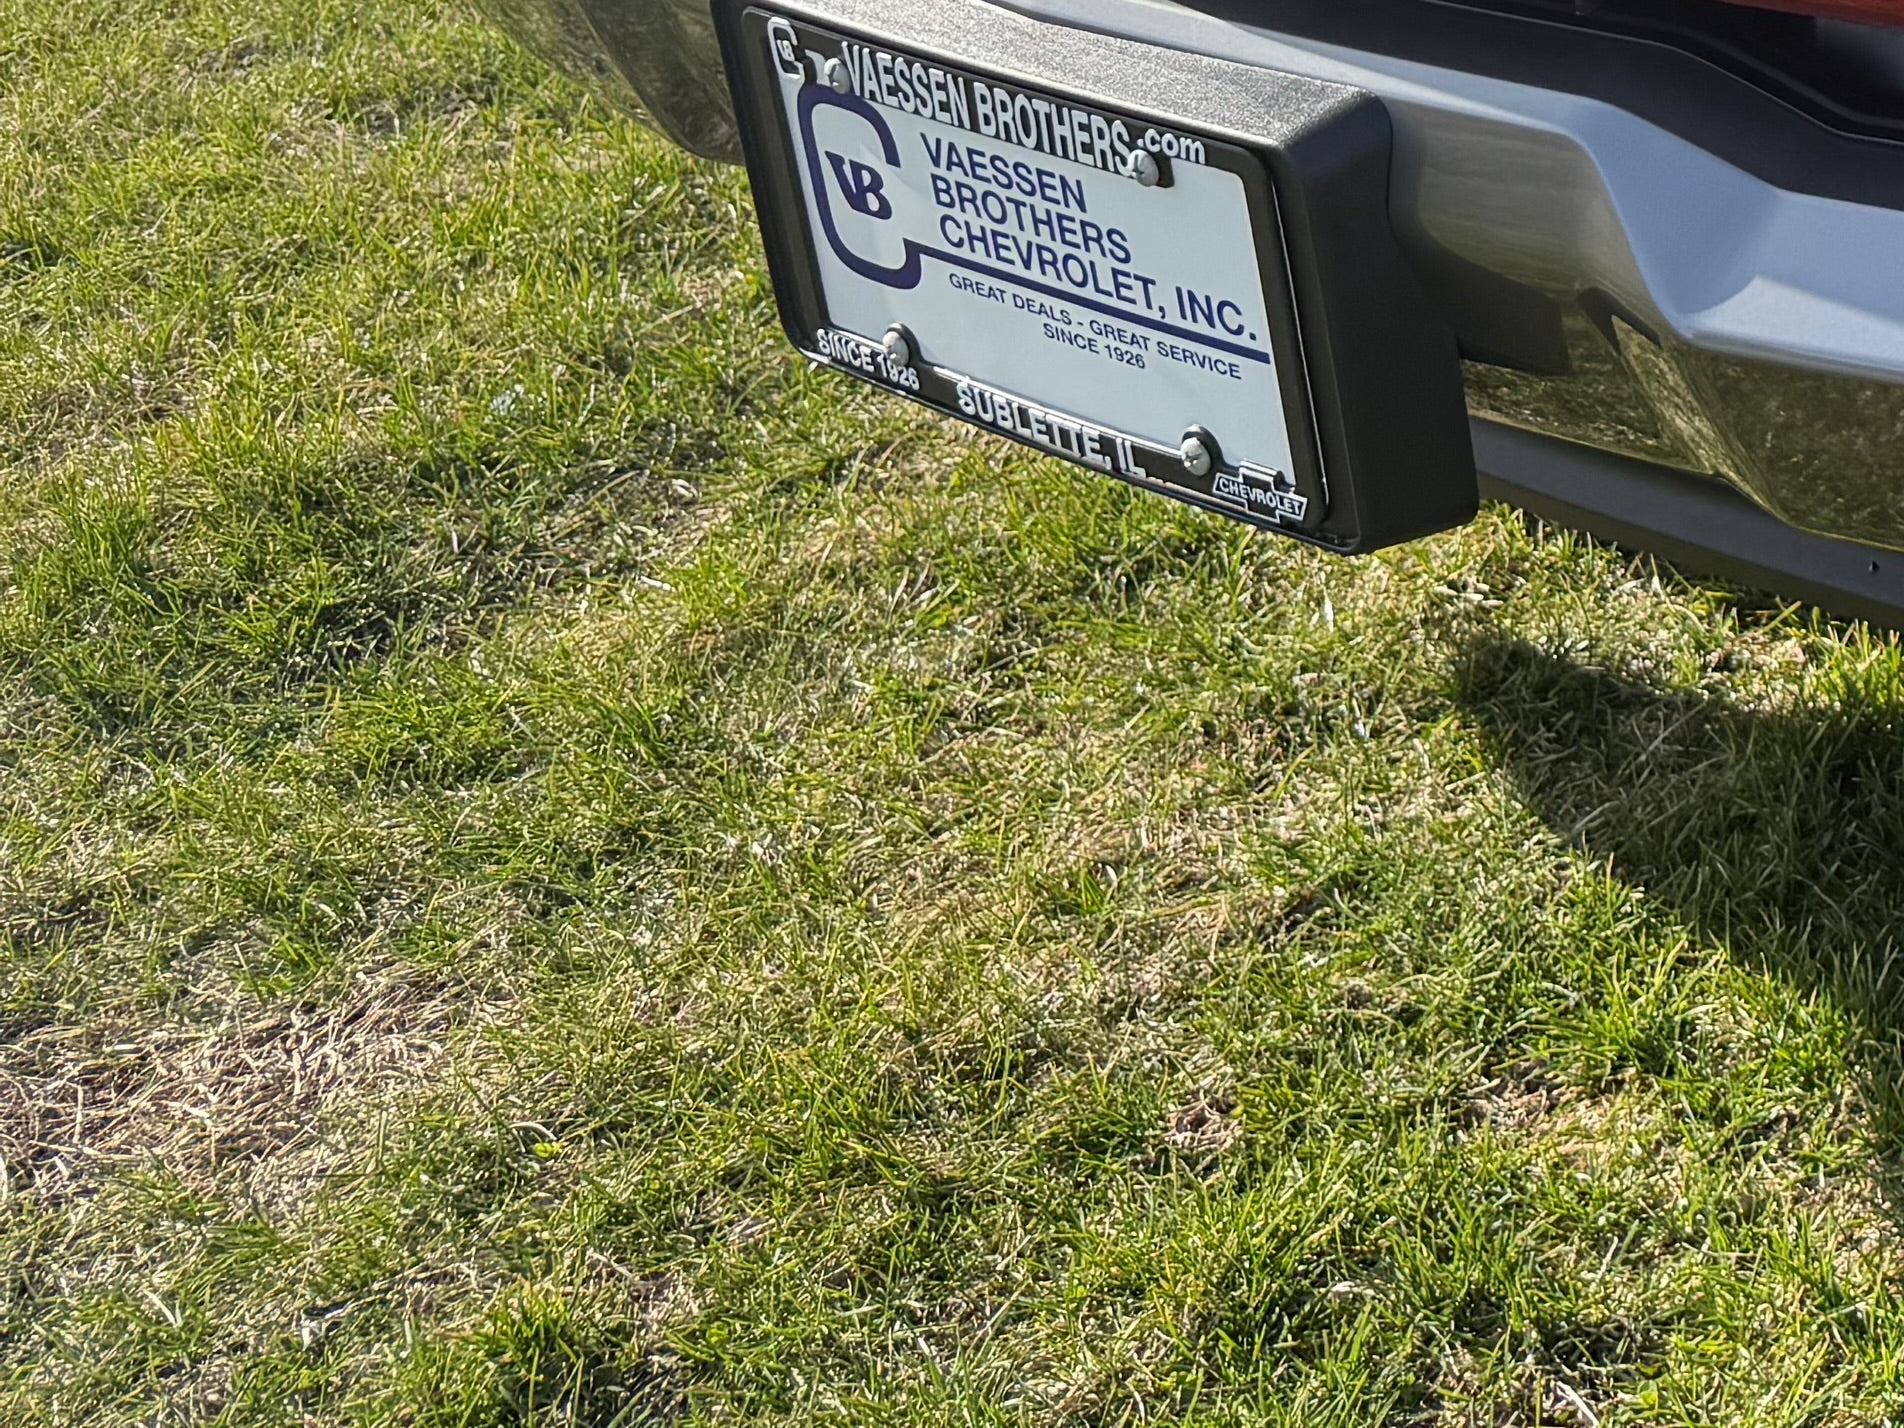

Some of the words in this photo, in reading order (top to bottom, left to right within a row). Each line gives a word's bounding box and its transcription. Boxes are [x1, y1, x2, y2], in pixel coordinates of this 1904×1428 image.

[841, 41, 972, 131] VAESSEN
[919, 131, 1088, 214] VAESSEN
[930, 172, 1132, 265] BROTHERS
[939, 212, 1167, 320] CHEVROLET,
[1175, 285, 1258, 342] INC.
[816, 328, 876, 374] SINCE
[876, 353, 921, 392] 1926
[948, 272, 1007, 305] GREAT
[1012, 293, 1073, 327] DEALS
[1088, 319, 1151, 352] GREAT
[1156, 341, 1243, 380] SERVICE
[1042, 322, 1100, 355] SINCE
[1103, 344, 1147, 370] 1926
[956, 381, 1113, 471] SUBLETTE,
[1115, 437, 1147, 479] IL
[1218, 478, 1302, 516] CHEVROLET
